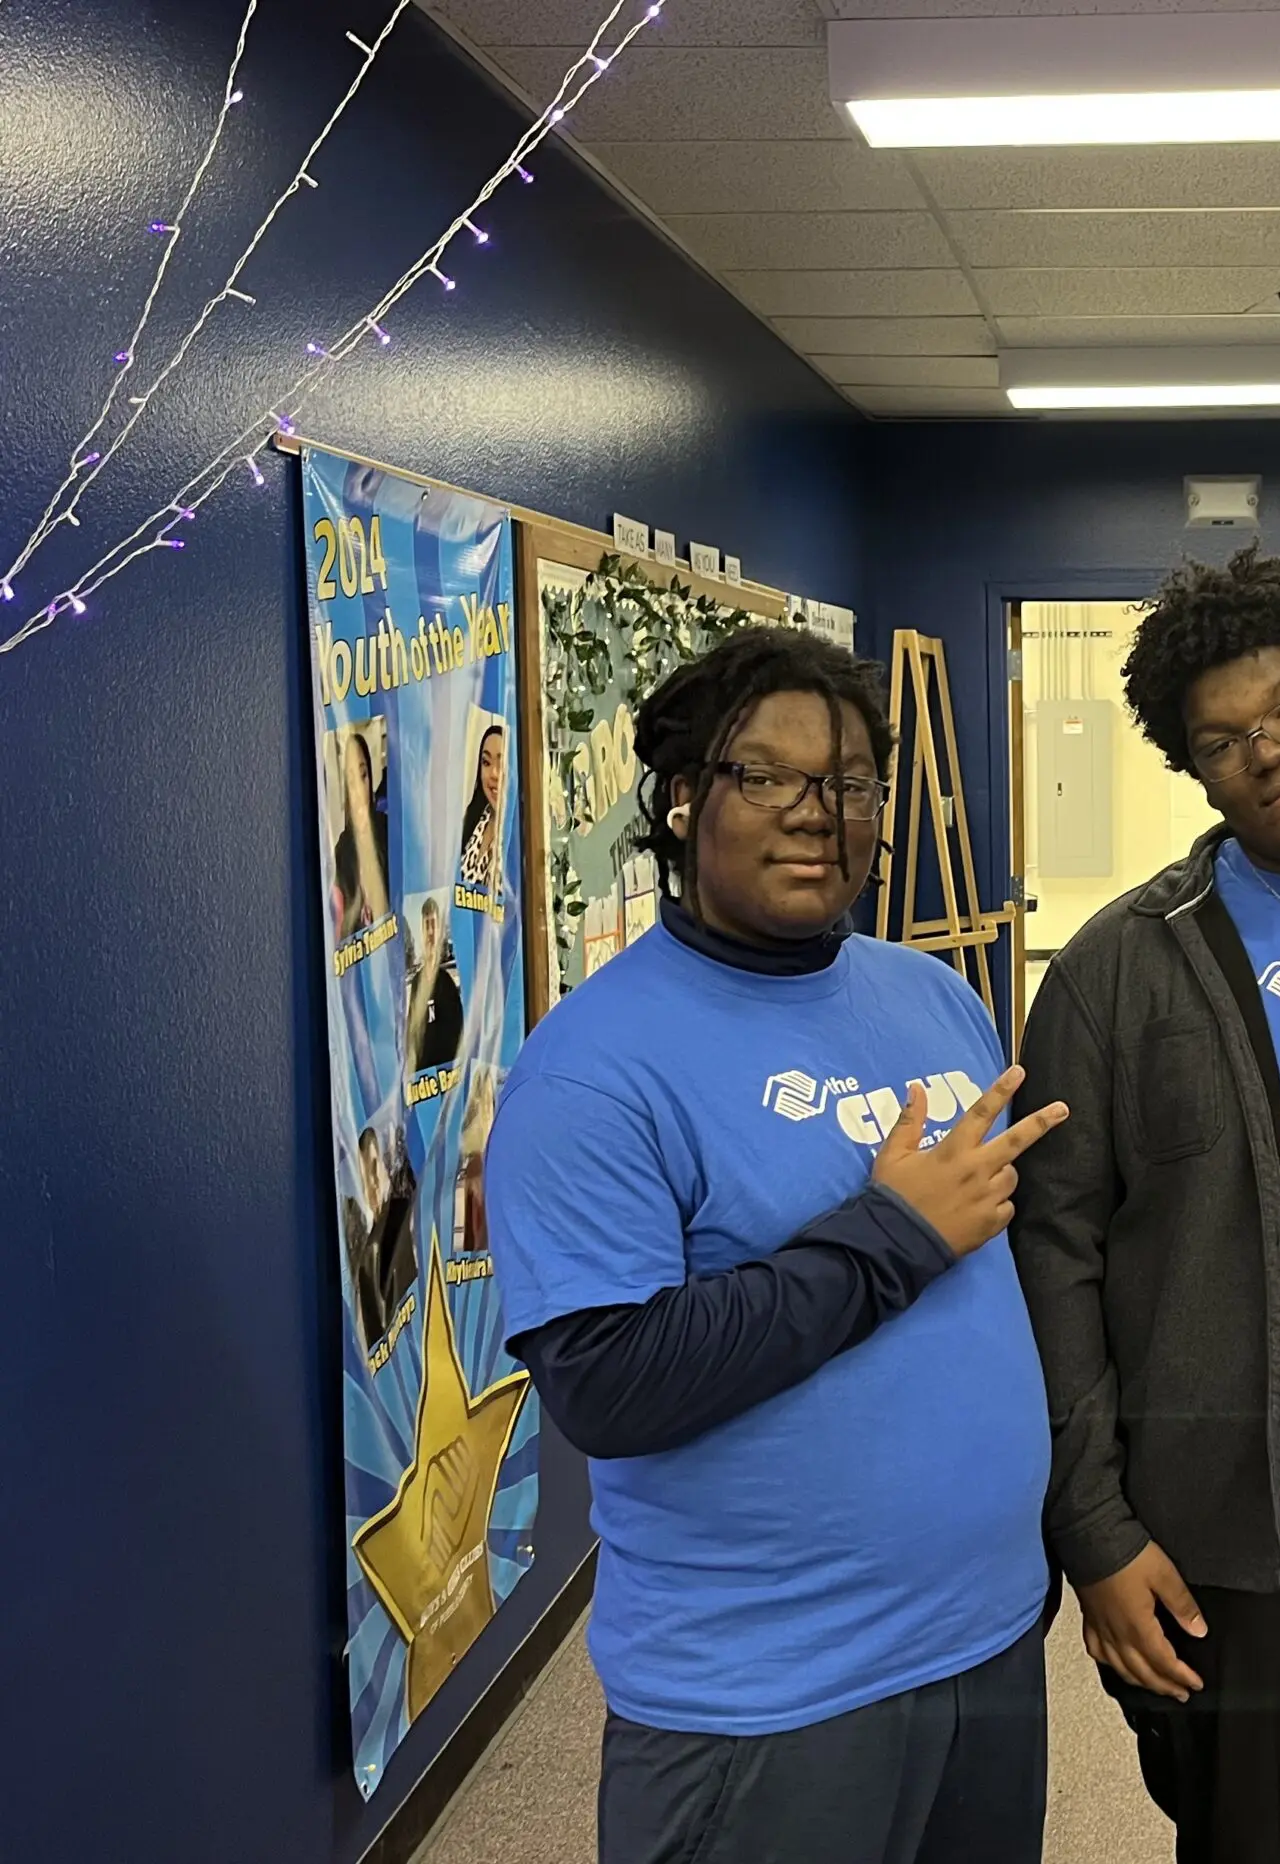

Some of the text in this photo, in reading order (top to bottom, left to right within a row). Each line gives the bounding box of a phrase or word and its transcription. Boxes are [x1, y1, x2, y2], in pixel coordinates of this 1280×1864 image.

[313, 514, 388, 600] 2024
[315, 592, 511, 706] Youth of the Year
[825, 1075, 860, 1096] the
